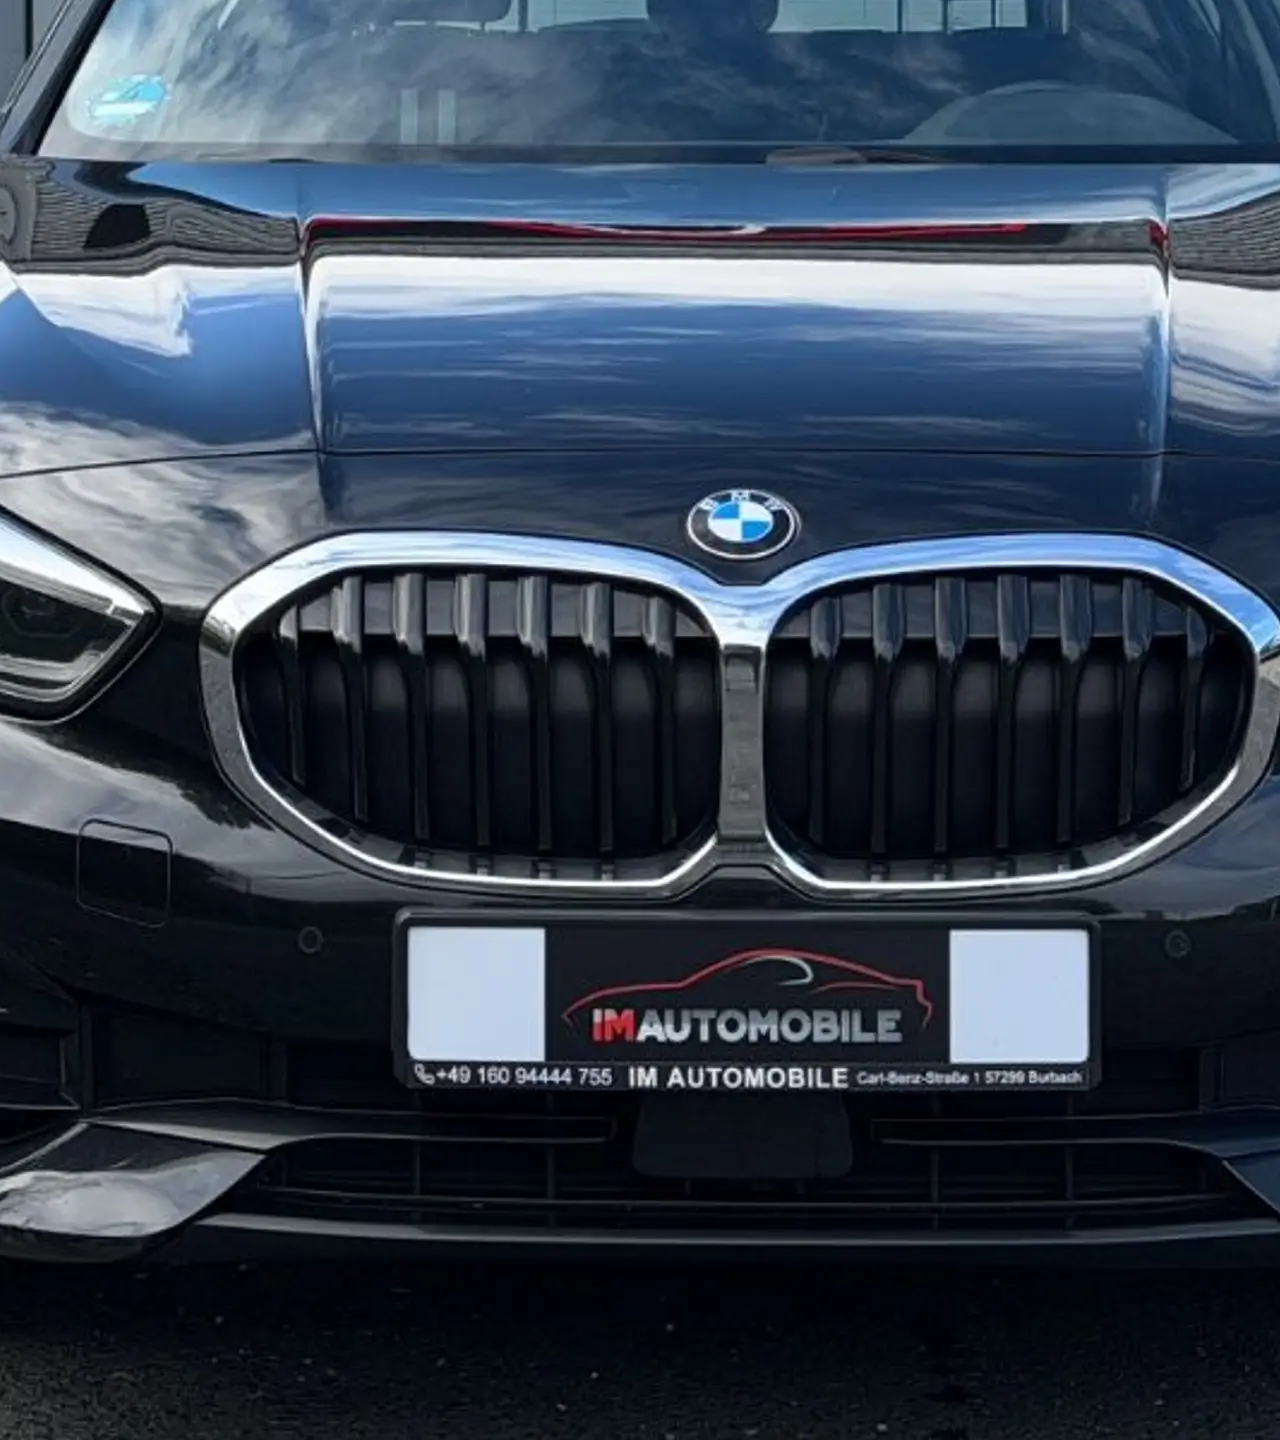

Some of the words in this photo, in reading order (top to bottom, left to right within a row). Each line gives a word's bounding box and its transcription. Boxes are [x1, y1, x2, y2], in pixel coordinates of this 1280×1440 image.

[436, 1065, 471, 1084] +49
[477, 1066, 510, 1085] 160
[515, 1066, 572, 1085] 94444
[578, 1067, 613, 1086] 755
[628, 1066, 658, 1088] IM
[667, 1066, 849, 1089] AUTOMOBILE
